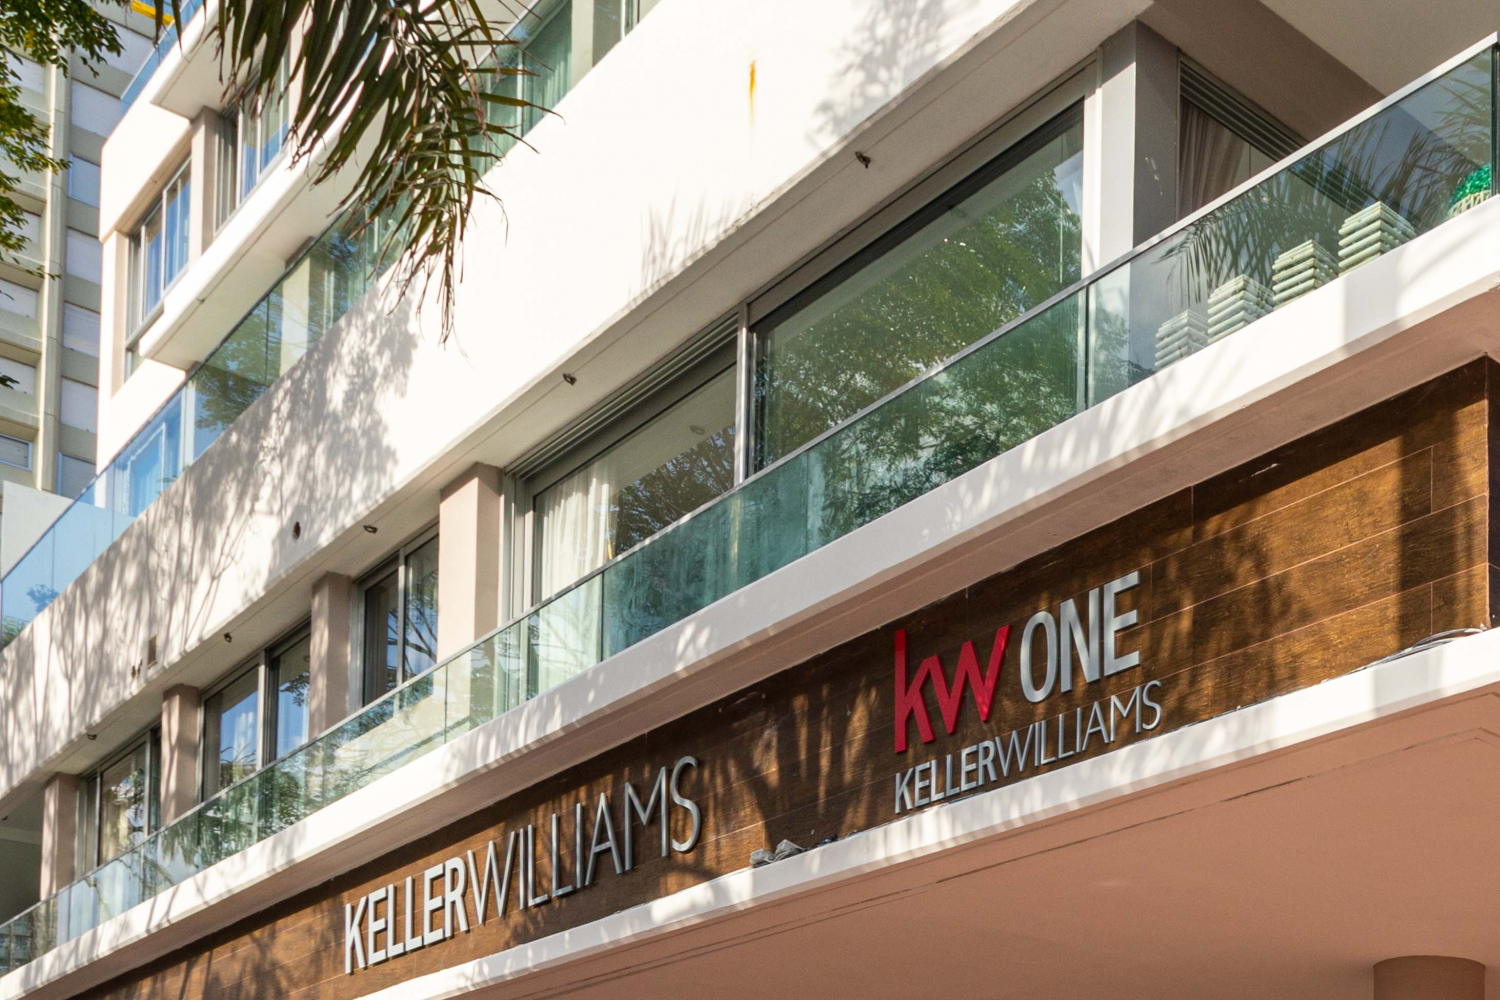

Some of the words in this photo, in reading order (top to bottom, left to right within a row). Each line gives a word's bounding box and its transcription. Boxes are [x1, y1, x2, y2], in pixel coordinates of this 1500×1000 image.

[1020, 571, 1140, 703] ONE
[895, 680, 1162, 814] KELLERWILLIAMS
[345, 755, 699, 974] KELLERWILLIAMS
